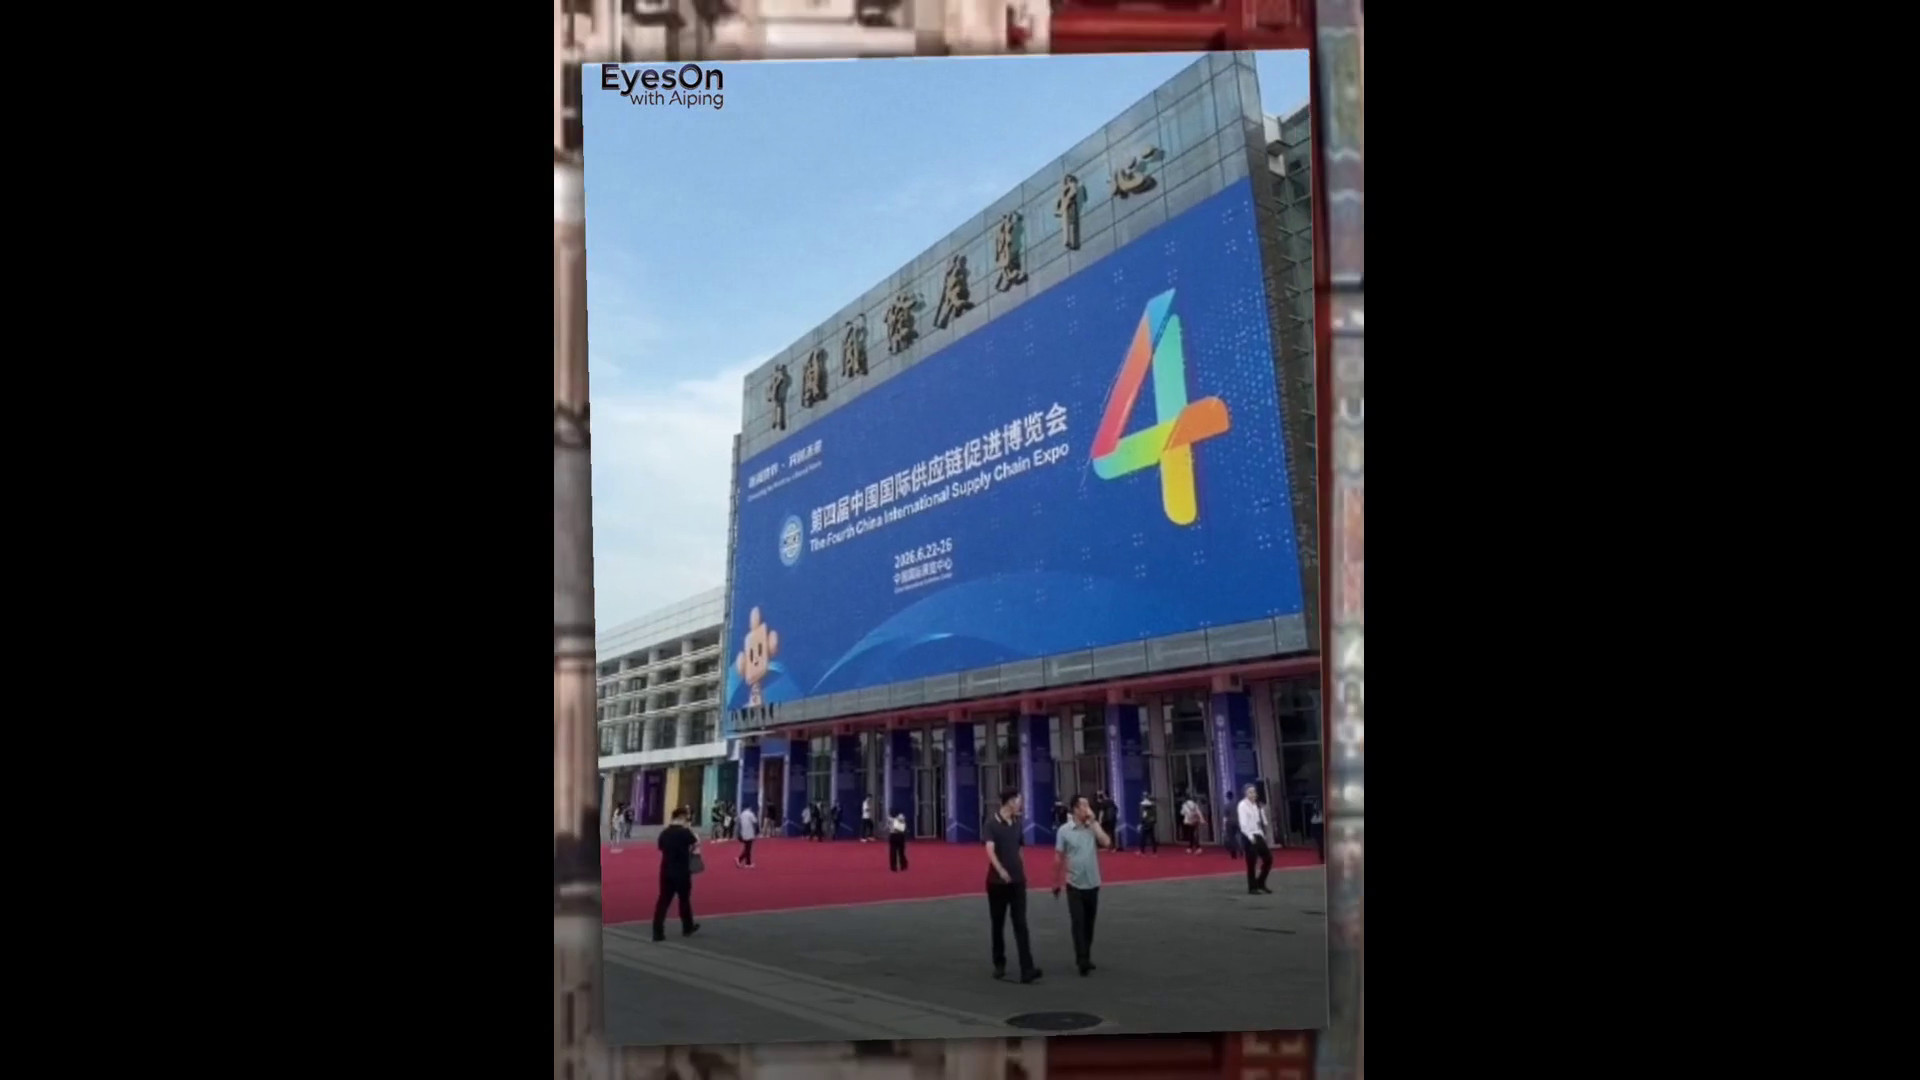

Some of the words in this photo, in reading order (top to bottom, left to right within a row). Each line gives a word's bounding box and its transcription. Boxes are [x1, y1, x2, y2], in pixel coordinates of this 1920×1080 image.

[810, 401, 1068, 535] 第四届中国国际供应链促进博览会
[1092, 288, 1230, 525] 4
[810, 537, 826, 552] The
[826, 523, 855, 546] Fourth
[855, 515, 883, 535] China
[884, 485, 950, 525] International
[952, 471, 992, 498] Supply
[993, 456, 1031, 481] Chain
[1033, 443, 1070, 467] Expo
